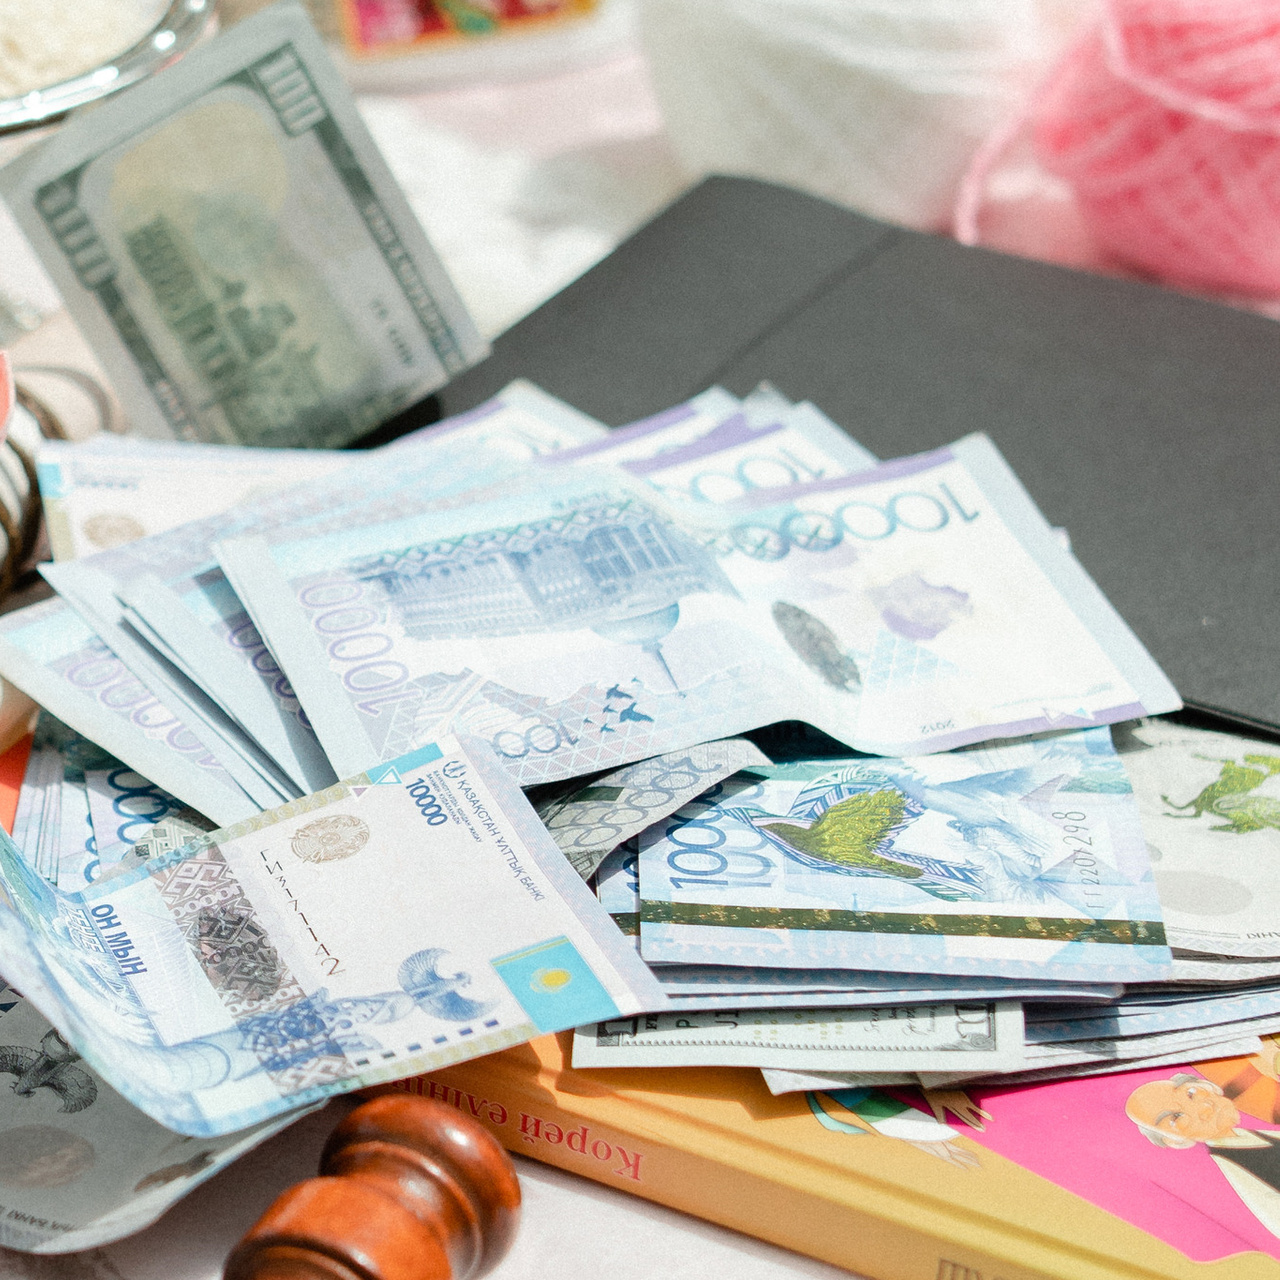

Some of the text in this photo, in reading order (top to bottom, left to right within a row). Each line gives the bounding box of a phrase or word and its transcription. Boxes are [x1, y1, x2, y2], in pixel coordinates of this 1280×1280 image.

[297, 574, 413, 717] 10000
[405, 777, 449, 827] 10000
[457, 778, 501, 837] ҚАЗАҚСТАН
[90, 903, 122, 931] ОН
[518, 1111, 645, 1182] Корей
